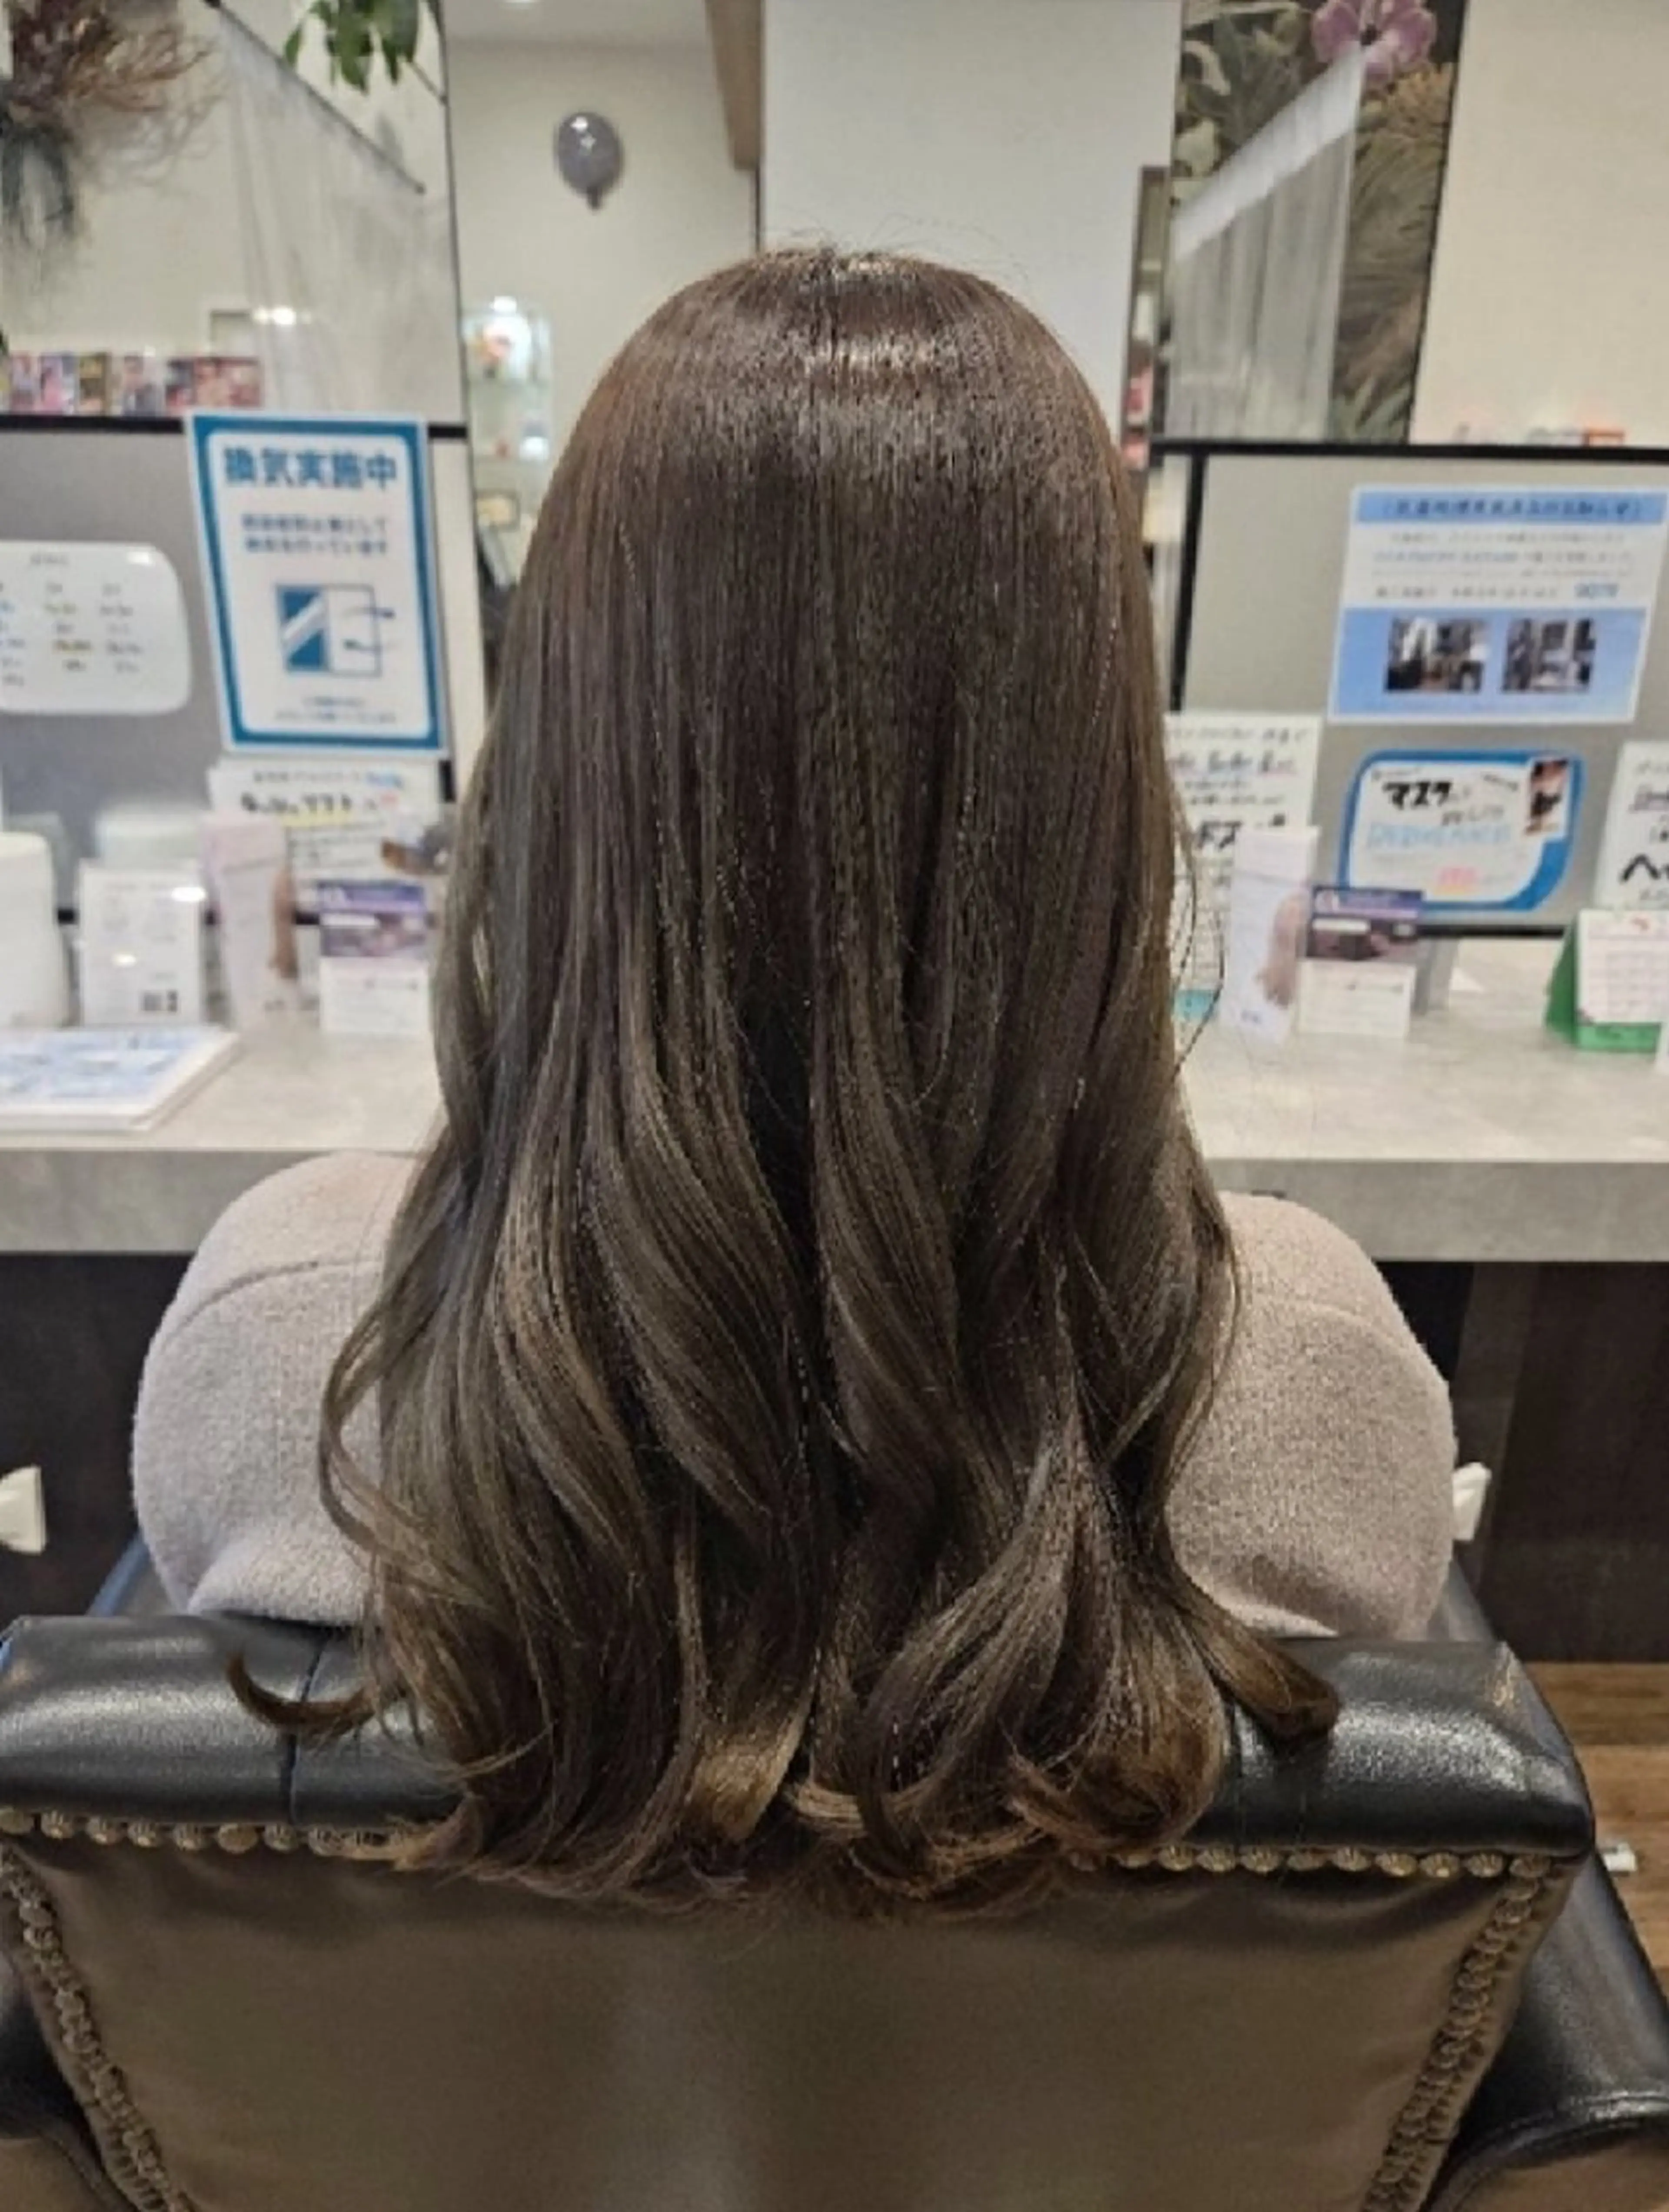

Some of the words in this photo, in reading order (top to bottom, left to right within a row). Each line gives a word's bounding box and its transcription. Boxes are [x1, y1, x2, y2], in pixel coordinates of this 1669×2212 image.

[223, 447, 396, 490] 換気実施中
